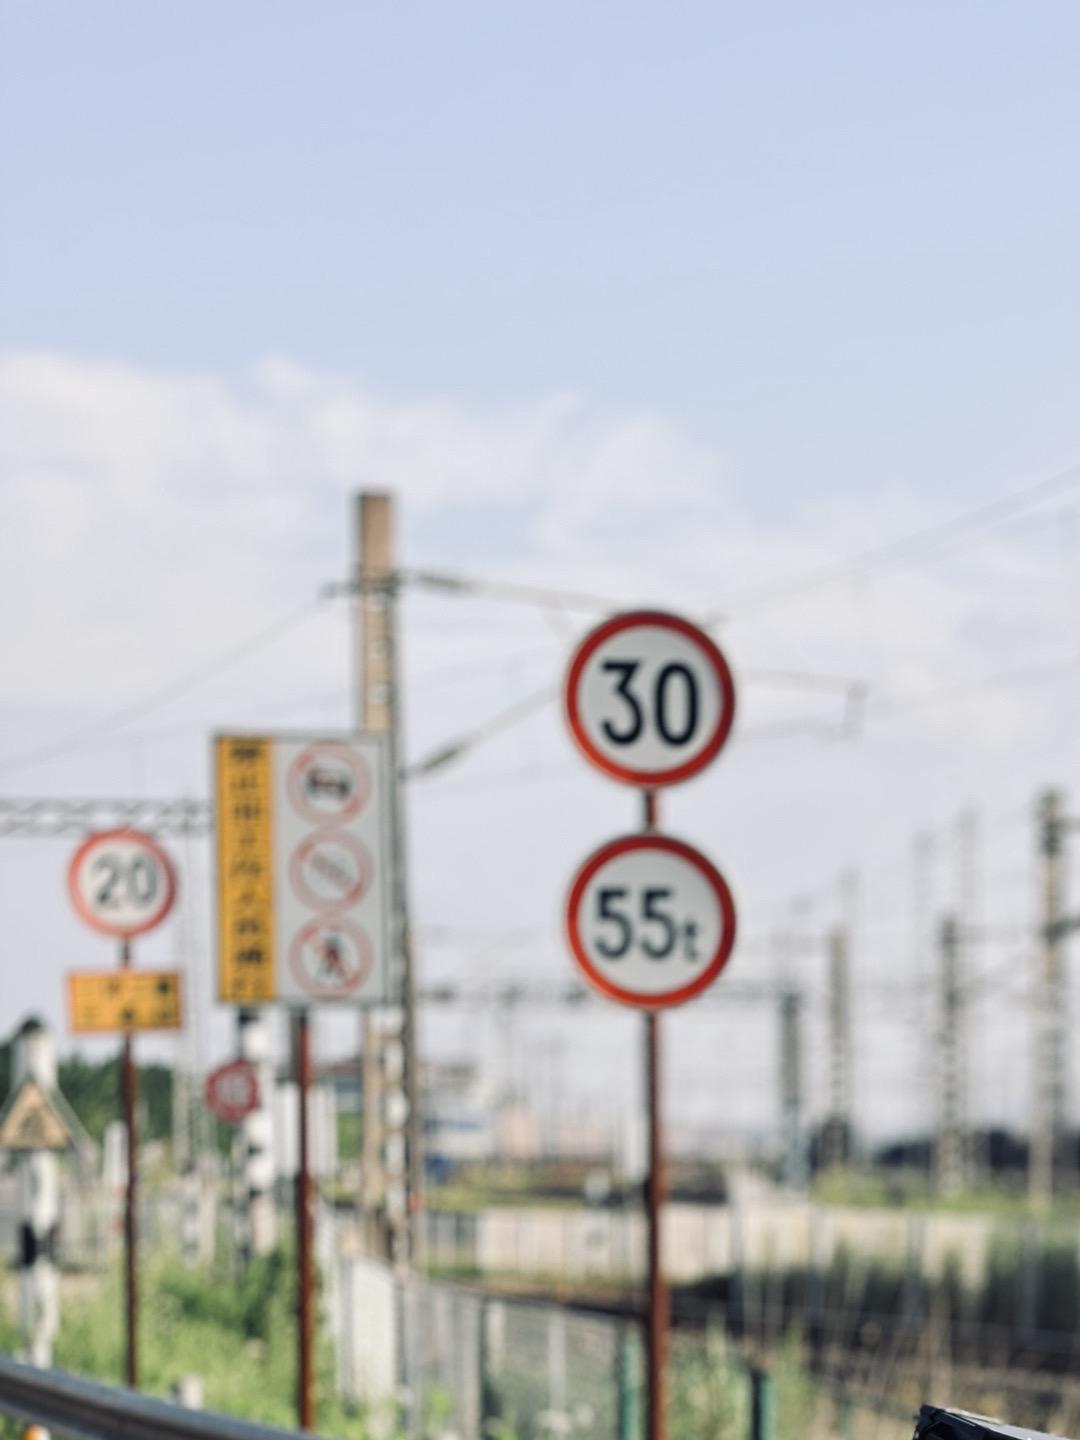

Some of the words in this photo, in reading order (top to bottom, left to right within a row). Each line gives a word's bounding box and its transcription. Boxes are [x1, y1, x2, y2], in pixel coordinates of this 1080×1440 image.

[601, 660, 700, 747] 30
[92, 854, 159, 907] 20
[595, 886, 702, 962] 55t
